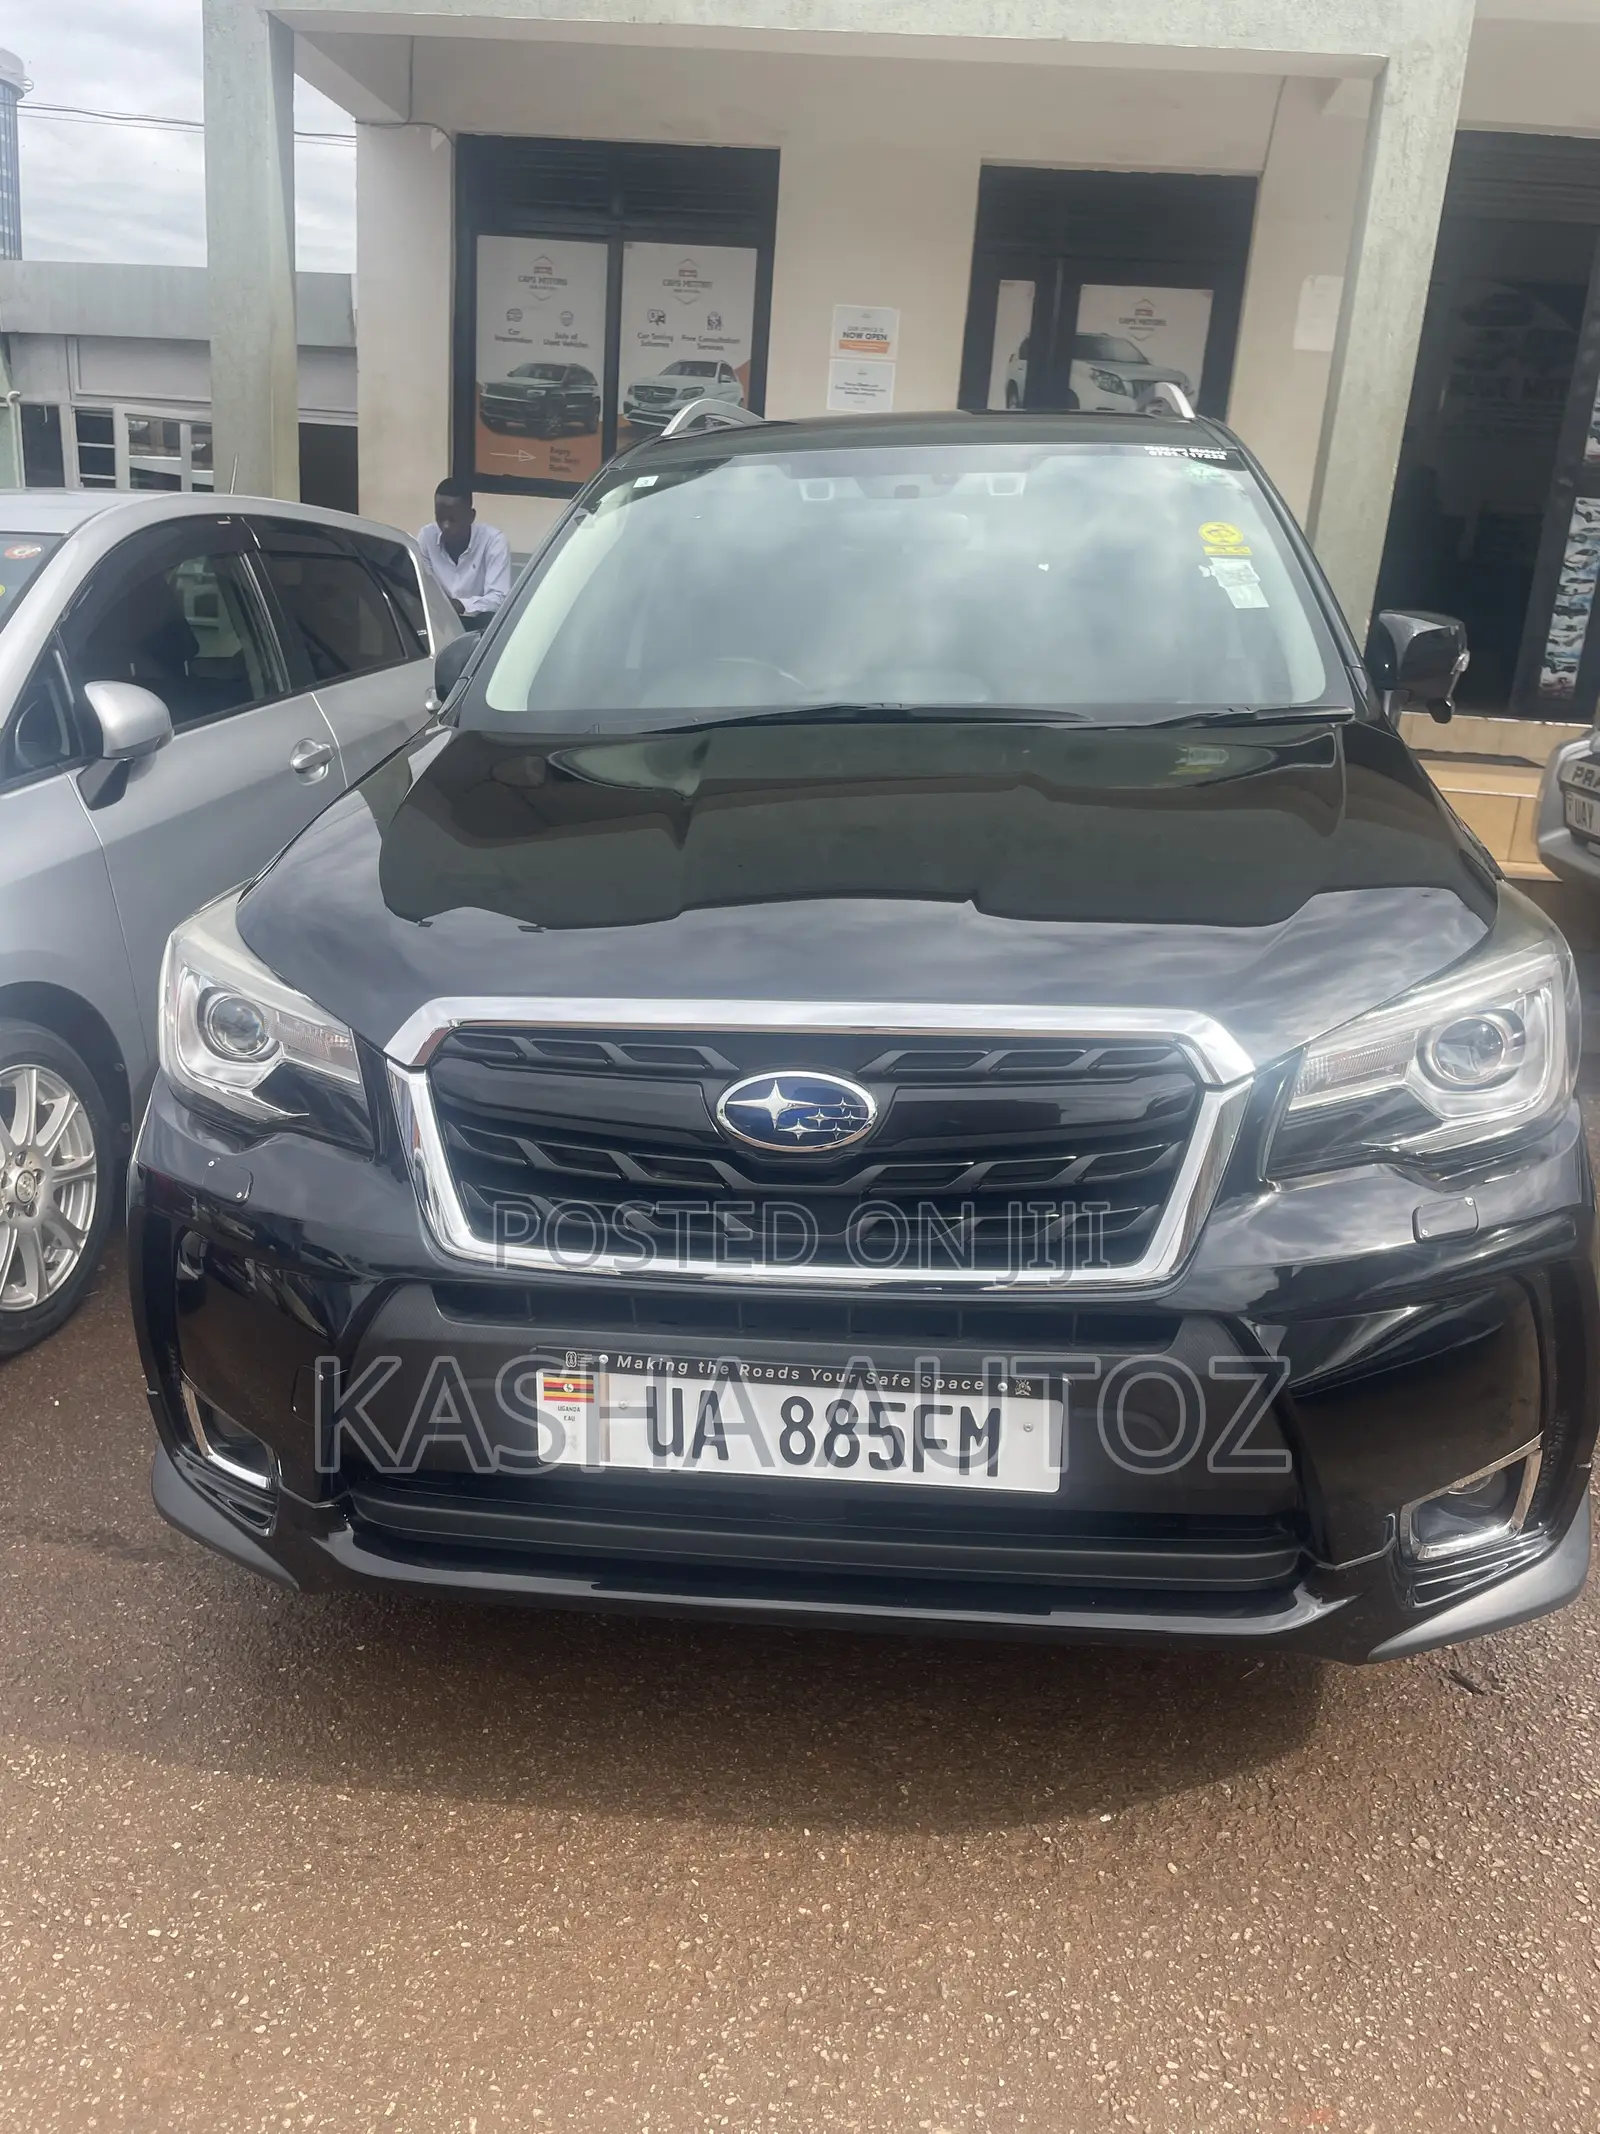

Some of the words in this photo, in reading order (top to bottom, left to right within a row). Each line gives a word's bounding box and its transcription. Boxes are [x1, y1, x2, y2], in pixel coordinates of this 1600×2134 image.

[842, 331, 863, 340] NOW
[864, 332, 888, 341] OPEN
[616, 1354, 689, 1375] Making
[698, 1361, 730, 1375] the
[739, 1362, 801, 1381] Roads
[810, 1367, 856, 1384] Your
[865, 1371, 911, 1387] Safe
[920, 1374, 985, 1393] Space
[645, 1384, 730, 1462] UA
[779, 1394, 1001, 1478] 885FM
